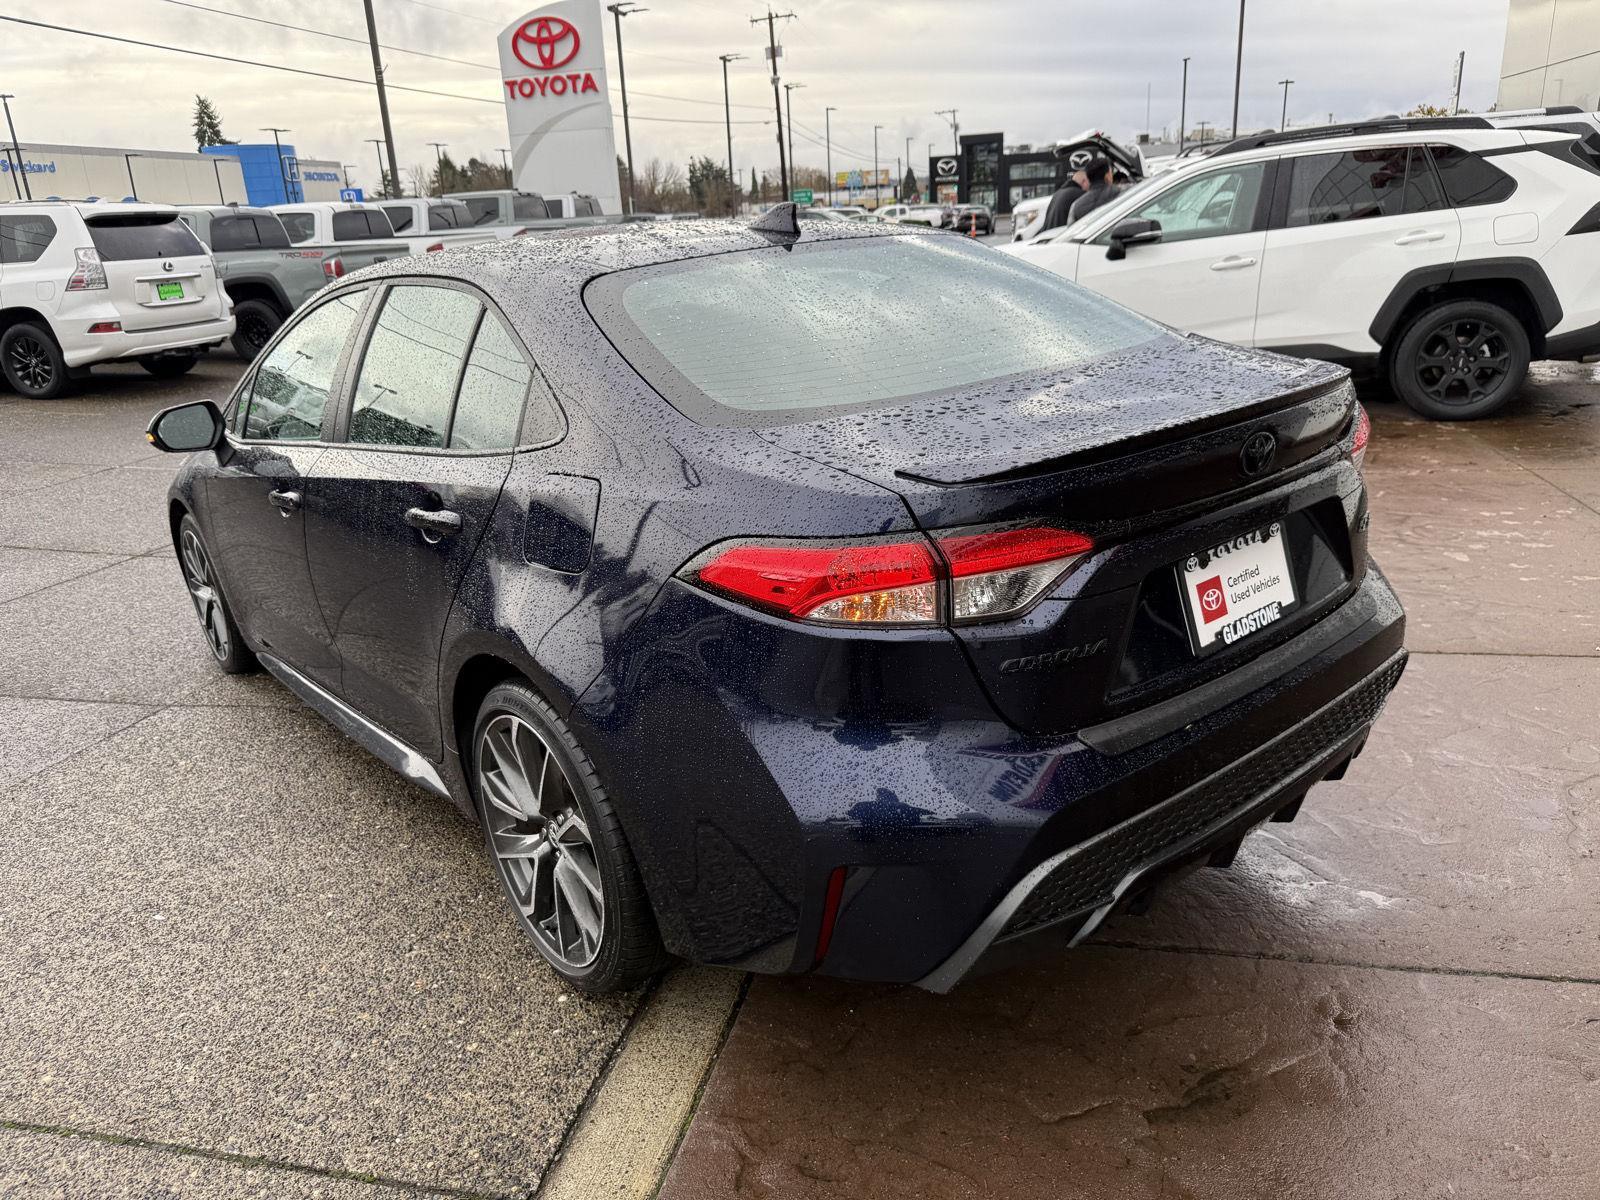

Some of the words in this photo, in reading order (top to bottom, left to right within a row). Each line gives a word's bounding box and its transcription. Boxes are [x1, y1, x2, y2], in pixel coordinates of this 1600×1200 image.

[505, 73, 599, 100] TOYOTA
[0, 159, 56, 173] Swckard
[1207, 530, 1262, 562] TOYOTA
[1227, 564, 1260, 588] Certified
[1230, 586, 1251, 604] Used
[1250, 574, 1281, 596] Vehicles
[1222, 602, 1281, 645] GLADSTONE
